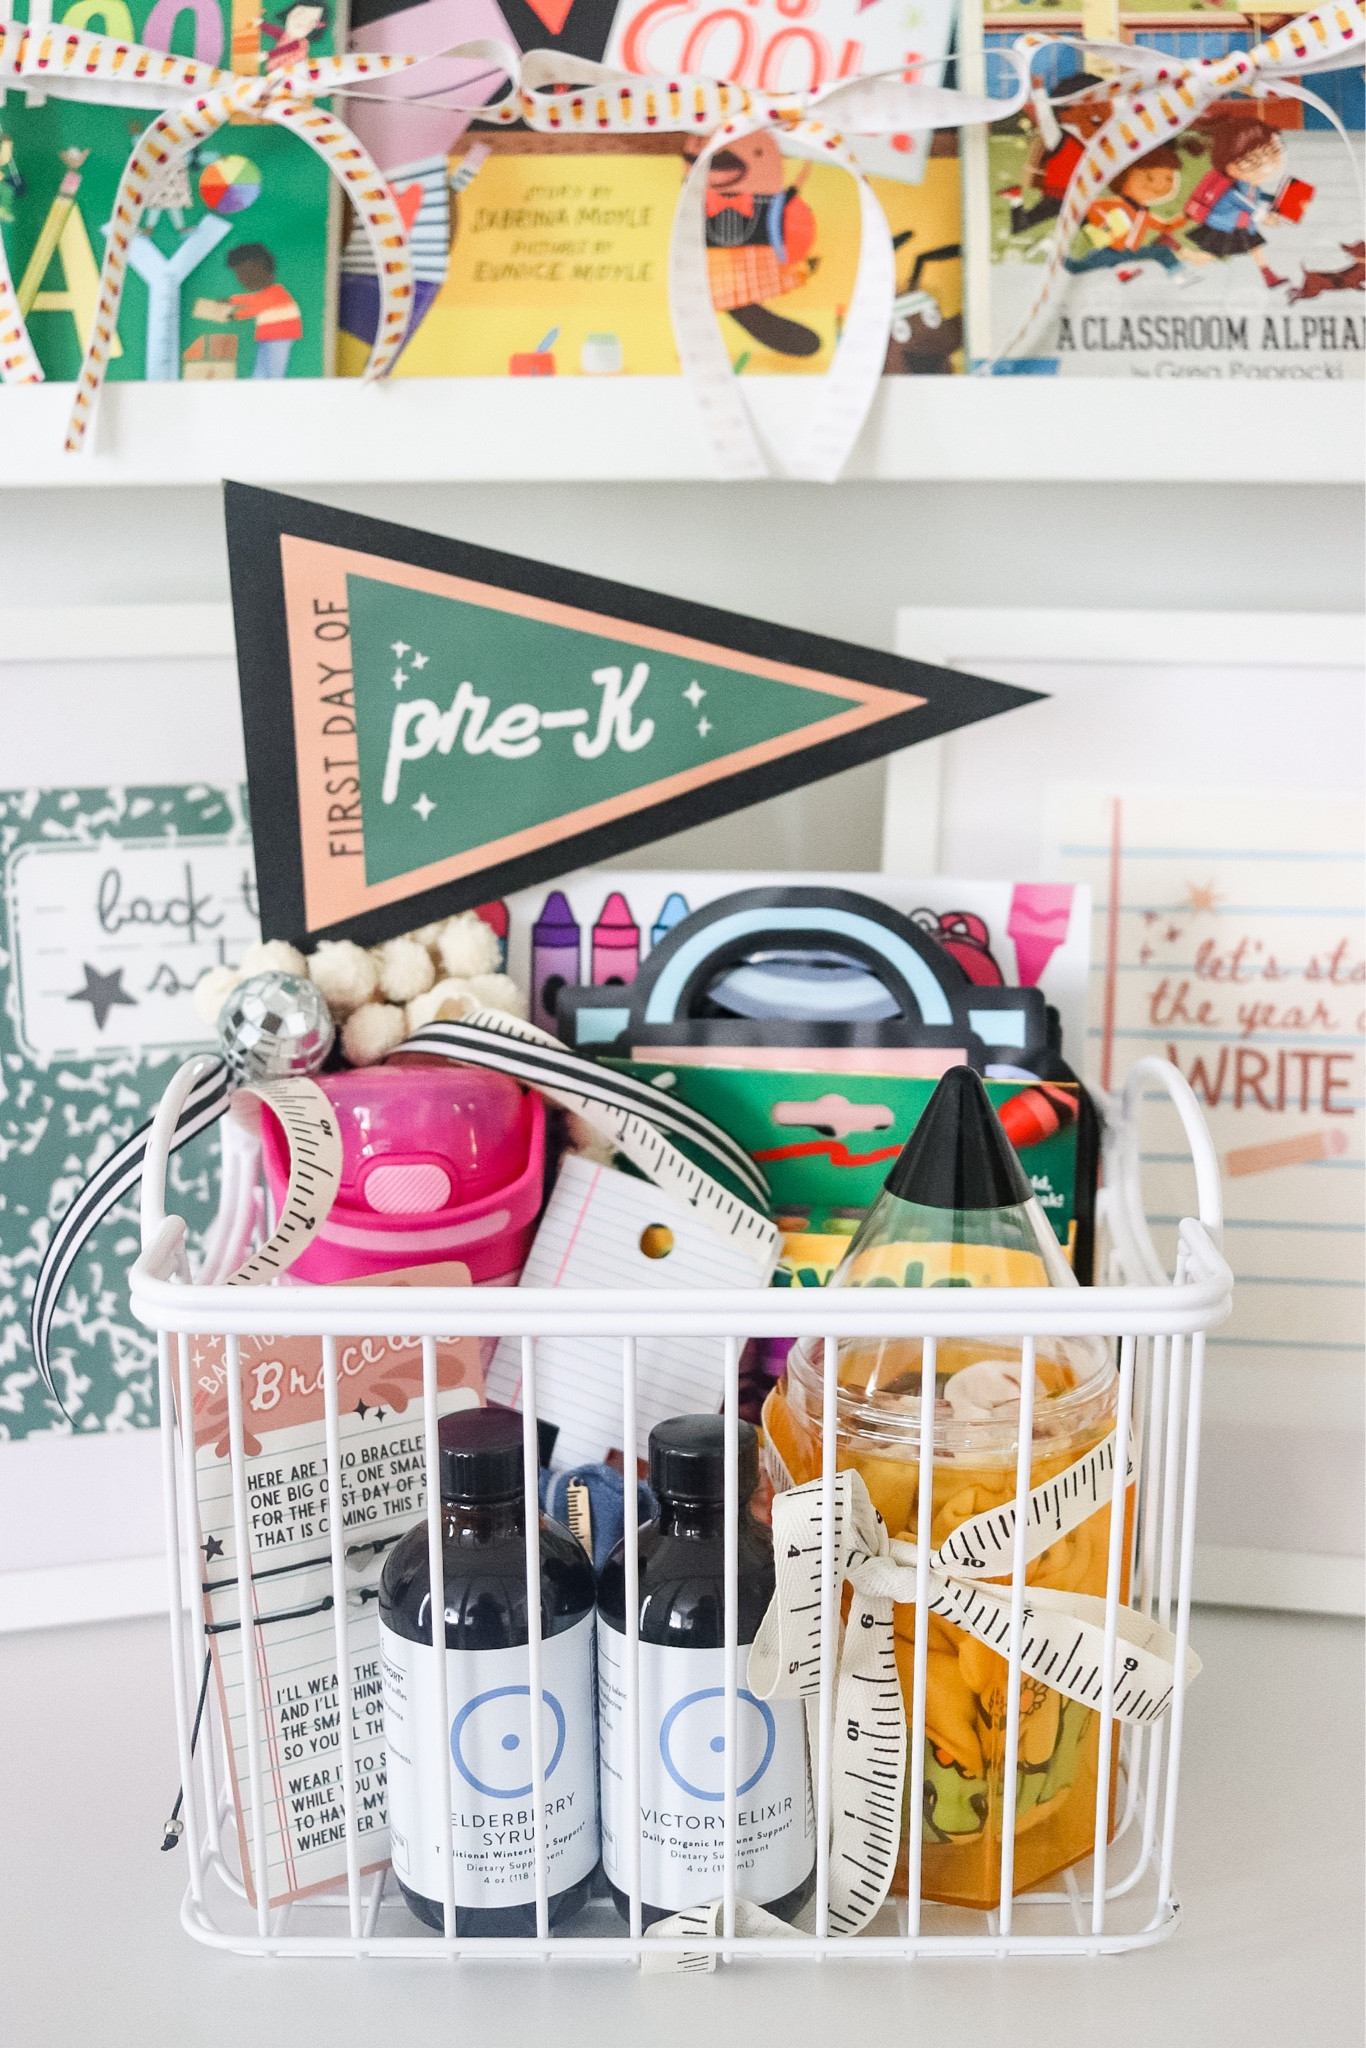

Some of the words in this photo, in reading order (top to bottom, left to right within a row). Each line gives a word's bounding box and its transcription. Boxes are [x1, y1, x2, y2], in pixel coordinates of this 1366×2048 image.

[1056, 315, 1077, 350] A
[1081, 315, 1252, 350] CLASSROOM
[1261, 315, 1366, 350] ALPHA
[313, 597, 351, 642] OF
[317, 661, 358, 736] DAY
[381, 662, 655, 805] pre-K
[324, 755, 364, 858] FIRST
[98, 857, 225, 944] back
[1149, 977, 1222, 1028] the
[1236, 999, 1339, 1041] year
[1166, 1042, 1356, 1116] WRITE
[247, 1469, 285, 1491] HERE
[290, 1461, 318, 1481] ARE
[322, 1452, 356, 1474] TO
[361, 1434, 426, 1464] BRACELE
[250, 1490, 283, 1510] ONE
[287, 1482, 314, 1502] BIG
[319, 1473, 353, 1493] OE,
[356, 1466, 385, 1484] ONE
[390, 1454, 427, 1475] SMAL
[252, 1511, 283, 1530] FOR
[288, 1502, 316, 1521] THE
[320, 1490, 357, 1513] FST
[361, 1482, 390, 1502] DAY
[396, 1476, 415, 1493] OF
[255, 1526, 295, 1548] THAT
[301, 1522, 314, 1539] IS
[318, 1505, 378, 1533] CMING
[383, 1496, 413, 1516] THIS
[787, 1544, 801, 1559] 4
[960, 1556, 987, 1569] 10
[276, 1684, 303, 1705] I'LL
[307, 1673, 340, 1695] WEA
[353, 1660, 380, 1681] THE
[788, 1661, 800, 1675] 5
[280, 1702, 310, 1724] AND
[314, 1693, 340, 1713] I'LL
[350, 1679, 383, 1701] HINK
[281, 1721, 309, 1742] THE
[313, 1699, 361, 1733] SMAL
[365, 1699, 384, 1717] ON
[283, 1743, 304, 1761] SO
[309, 1726, 361, 1753] YOUL
[846, 1718, 860, 1742] 10
[288, 1769, 331, 1795] WEAR
[354, 1756, 375, 1774] TO
[291, 1787, 336, 1814] WHILE
[293, 1814, 315, 1832] TO
[320, 1803, 351, 1825] HAV
[363, 1790, 385, 1811] MY
[451, 1791, 576, 1829] ELDERBRRY
[640, 1807, 725, 1830] VICTORY
[738, 1797, 793, 1827] ELIXIR
[296, 1809, 374, 1852] WHENEER
[483, 1824, 549, 1847] SYRU
[641, 1830, 666, 1846] Daily
[669, 1837, 710, 1849] Organic
[714, 1835, 754, 1847] Imune
[466, 1862, 505, 1873] Dietary
[509, 1849, 564, 1871] Supplent
[670, 1849, 708, 1862] Dietary
[712, 1844, 769, 1860] Sulement
